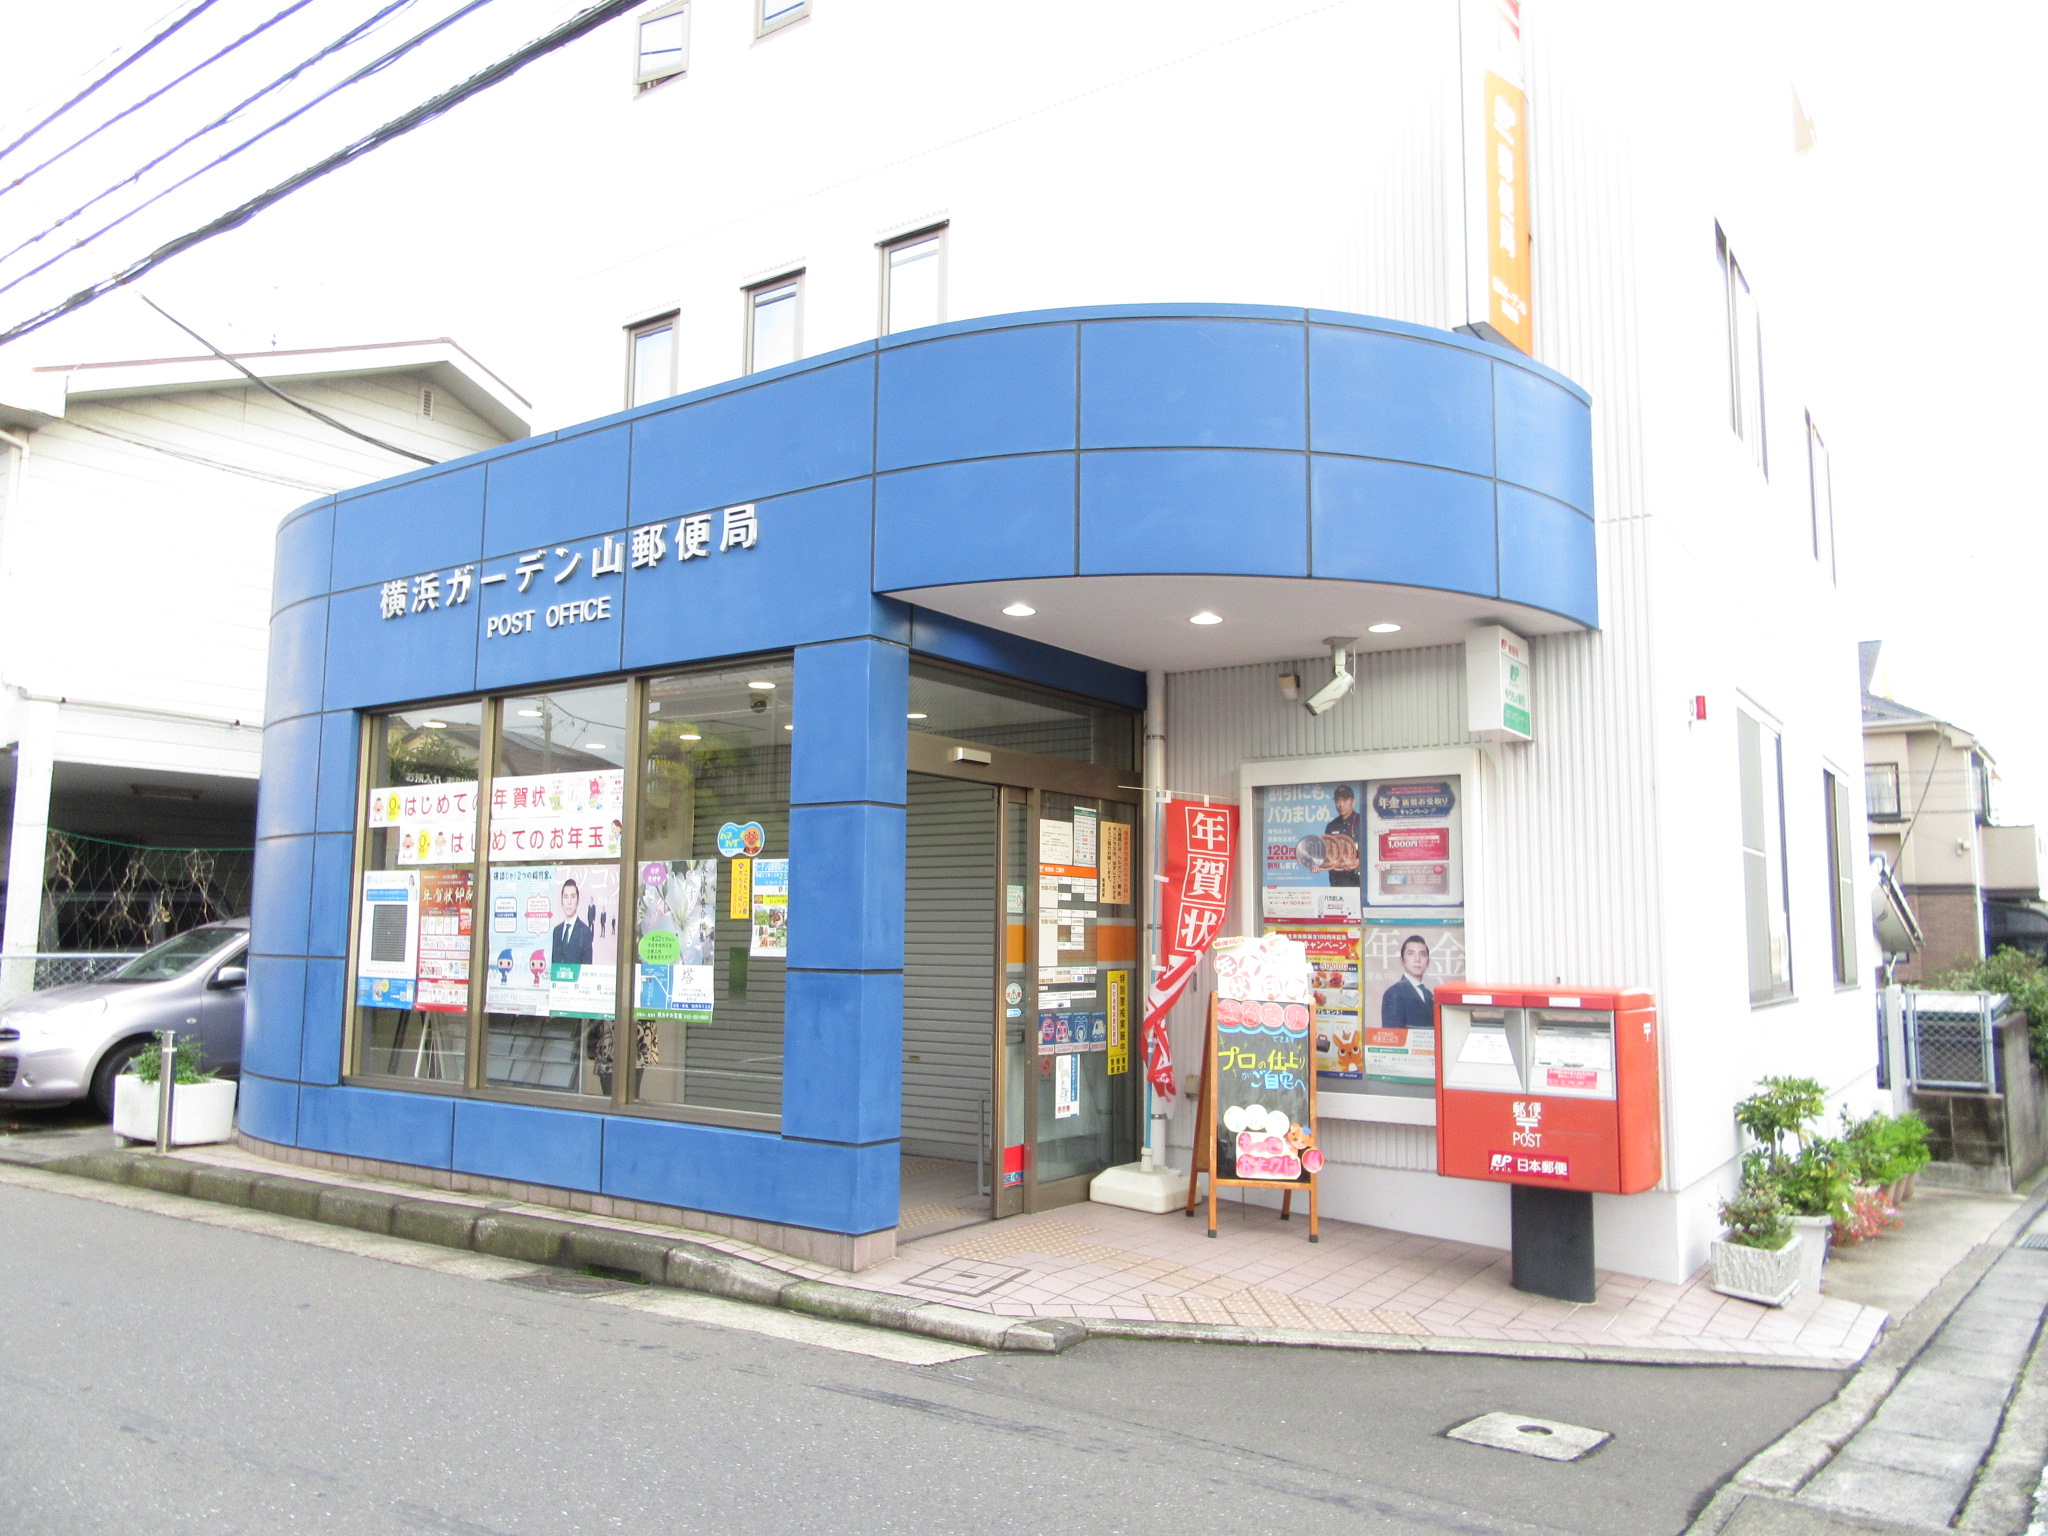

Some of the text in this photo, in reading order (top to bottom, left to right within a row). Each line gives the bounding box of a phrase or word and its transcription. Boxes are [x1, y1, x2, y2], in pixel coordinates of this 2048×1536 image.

[380, 503, 759, 620] 横浜ガーデン山郵便局
[487, 596, 611, 638] POST OFFICE
[1183, 811, 1226, 947] 年賀状
[1320, 962, 1348, 972] 50,000
[1218, 1046, 1306, 1071] プロの仕上り
[1512, 1101, 1542, 1120] 郵便
[1512, 1132, 1542, 1148] POST
[1517, 1158, 1568, 1176] 日本郵便
